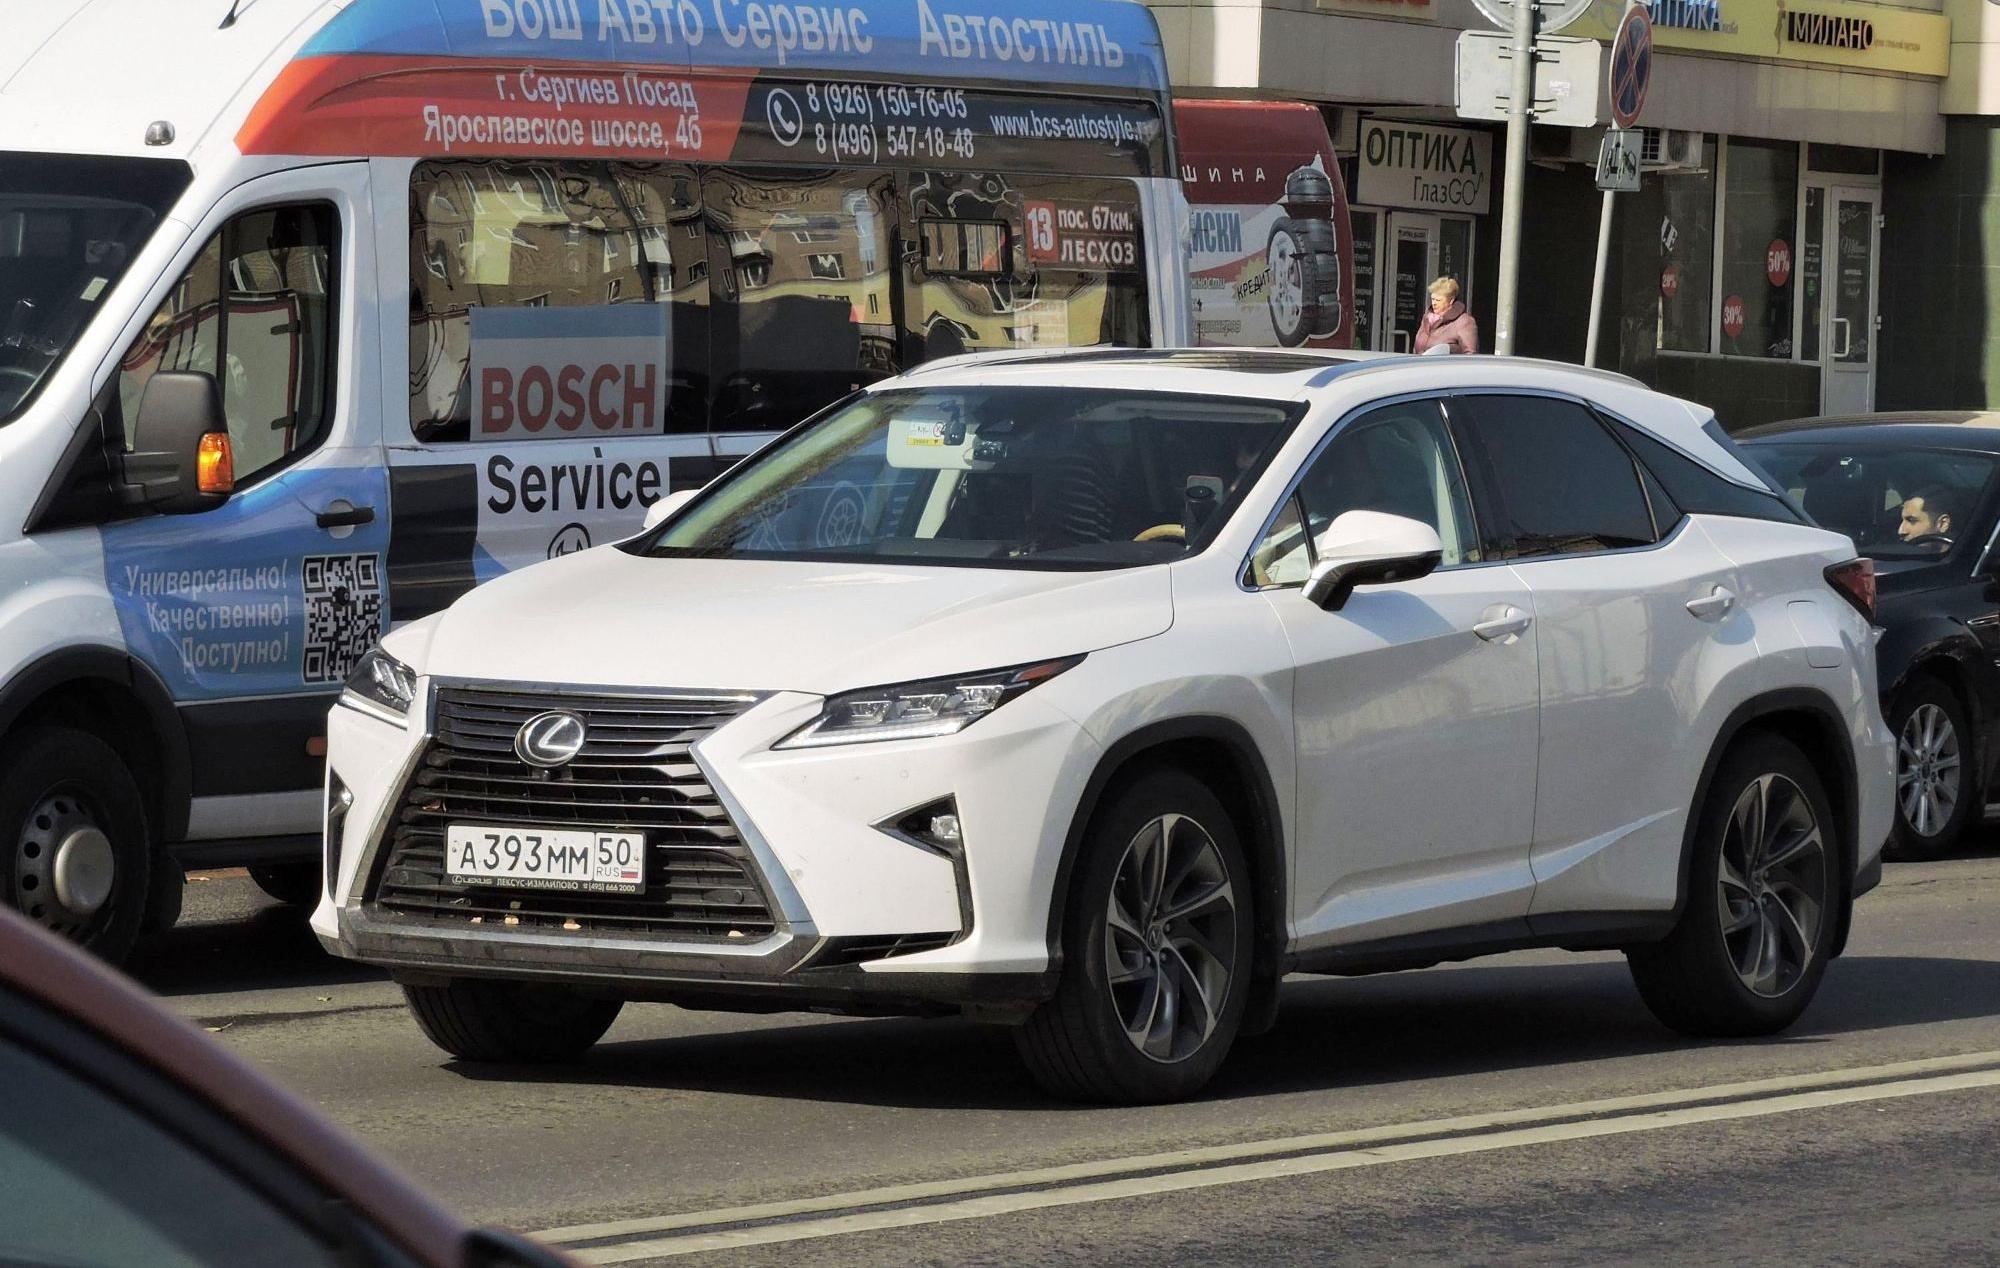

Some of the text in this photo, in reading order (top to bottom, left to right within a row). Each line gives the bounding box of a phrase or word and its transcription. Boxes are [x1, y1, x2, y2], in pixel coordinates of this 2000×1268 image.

[712, 0, 874, 66] Сервис
[1793, 11, 1874, 50] МИЛАНО
[519, 66, 620, 111] Сергиев
[623, 71, 699, 114] Посад
[806, 82, 968, 123] 8 (926) 150-76-05
[423, 105, 584, 151] Ярославское
[591, 119, 670, 155] шоссе,
[815, 122, 975, 164] 8 (496) 547-18-48
[1366, 127, 1477, 175] ОПТИКА
[1027, 207, 1055, 251] 13
[1057, 208, 1088, 232] пос.
[1060, 239, 1135, 265] ЛЕСХОЗ
[1767, 250, 1790, 274] 50%
[1236, 269, 1271, 301] КРЕДИТ
[1723, 303, 1744, 324] 30%
[481, 363, 656, 433] BOSCH
[487, 446, 661, 514] Service
[124, 558, 288, 598] Универсально!
[146, 596, 289, 633] Качественно!
[182, 632, 289, 673] Доступно!
[596, 866, 620, 877] RUS
[598, 837, 631, 866] 50
